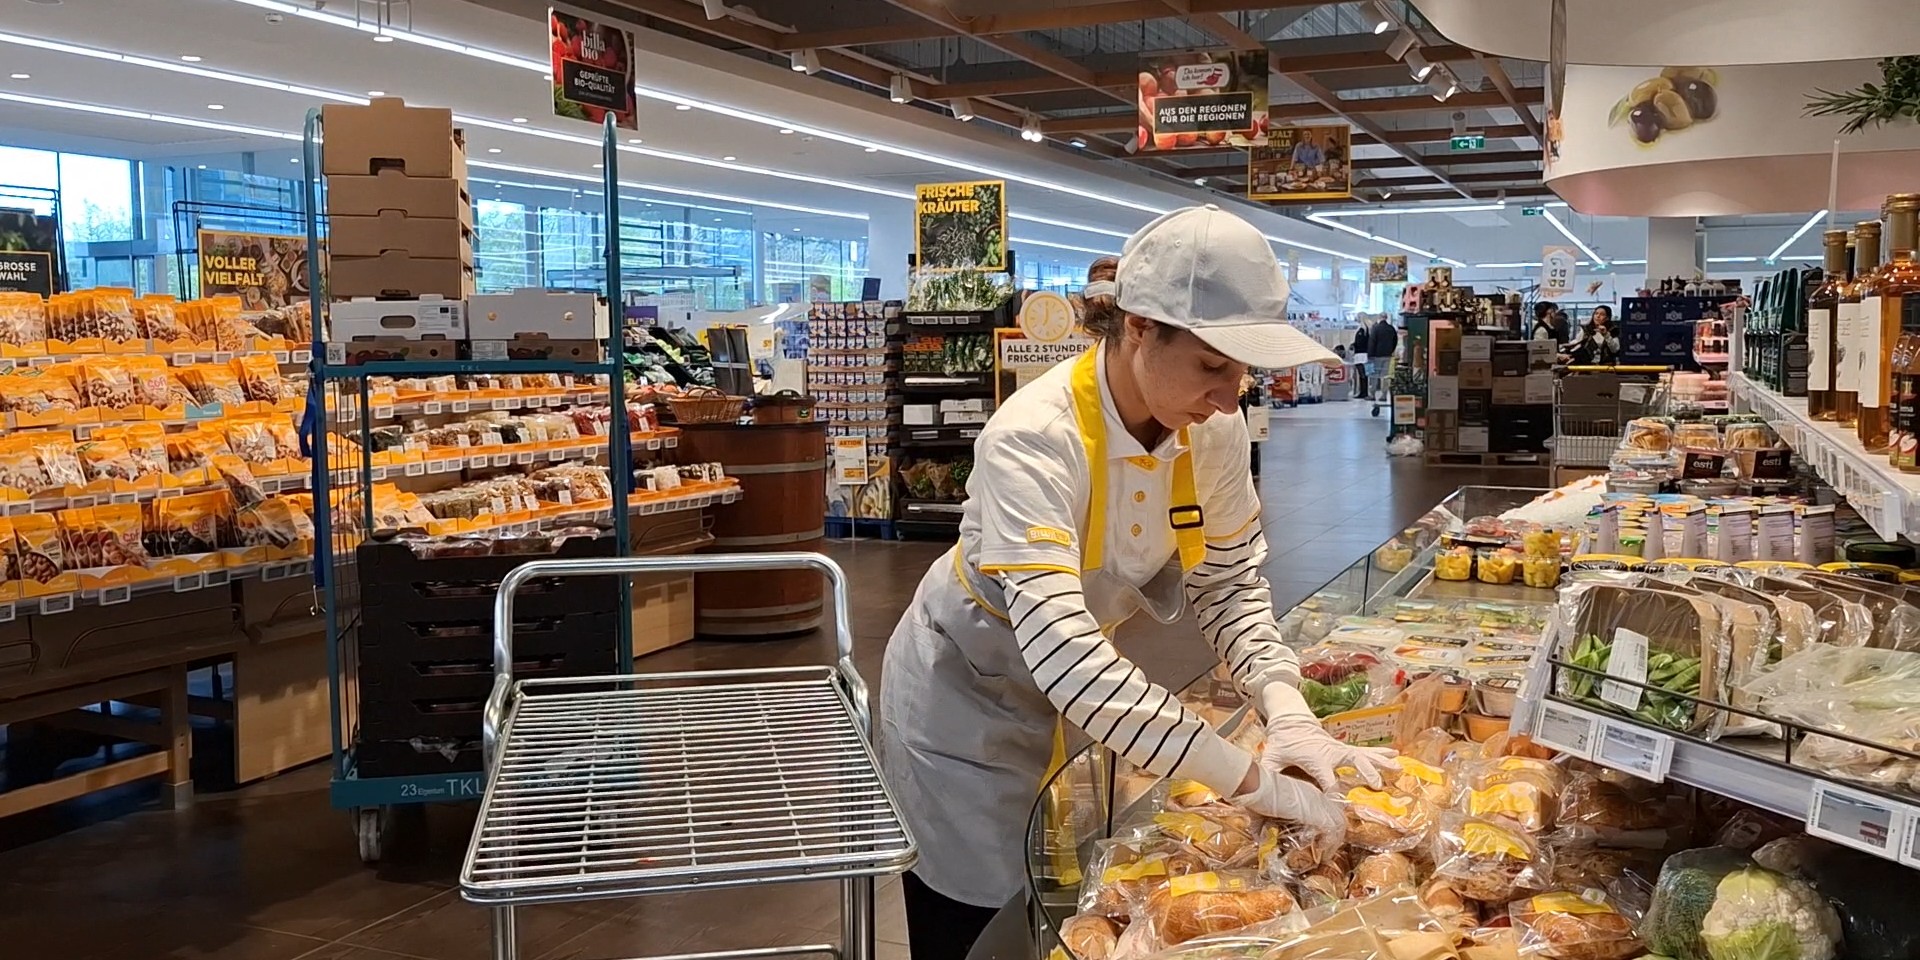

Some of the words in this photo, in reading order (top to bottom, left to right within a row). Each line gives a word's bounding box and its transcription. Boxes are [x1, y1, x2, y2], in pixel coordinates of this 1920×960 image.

[583, 30, 606, 52] billa
[581, 41, 599, 60] bio
[579, 70, 609, 84] GEPRÜFTE
[574, 77, 616, 94] BIO-QUALITÄT
[1159, 107, 1176, 116] AUS
[1178, 106, 1196, 115] DEN
[1199, 104, 1247, 114] REGIONEN
[1161, 113, 1178, 124] FÜR
[1180, 114, 1196, 123] DIE
[1198, 111, 1245, 122] REGIONEN
[918, 185, 975, 198] FRISCHE
[918, 198, 980, 214] KRÄUTER
[205, 255, 257, 270] VOLLER
[205, 271, 265, 286] VIELFALT
[1007, 344, 1032, 353] ALLE
[1034, 344, 1040, 353] 2
[400, 783, 418, 797] 23
[418, 787, 445, 797] Eigentum
